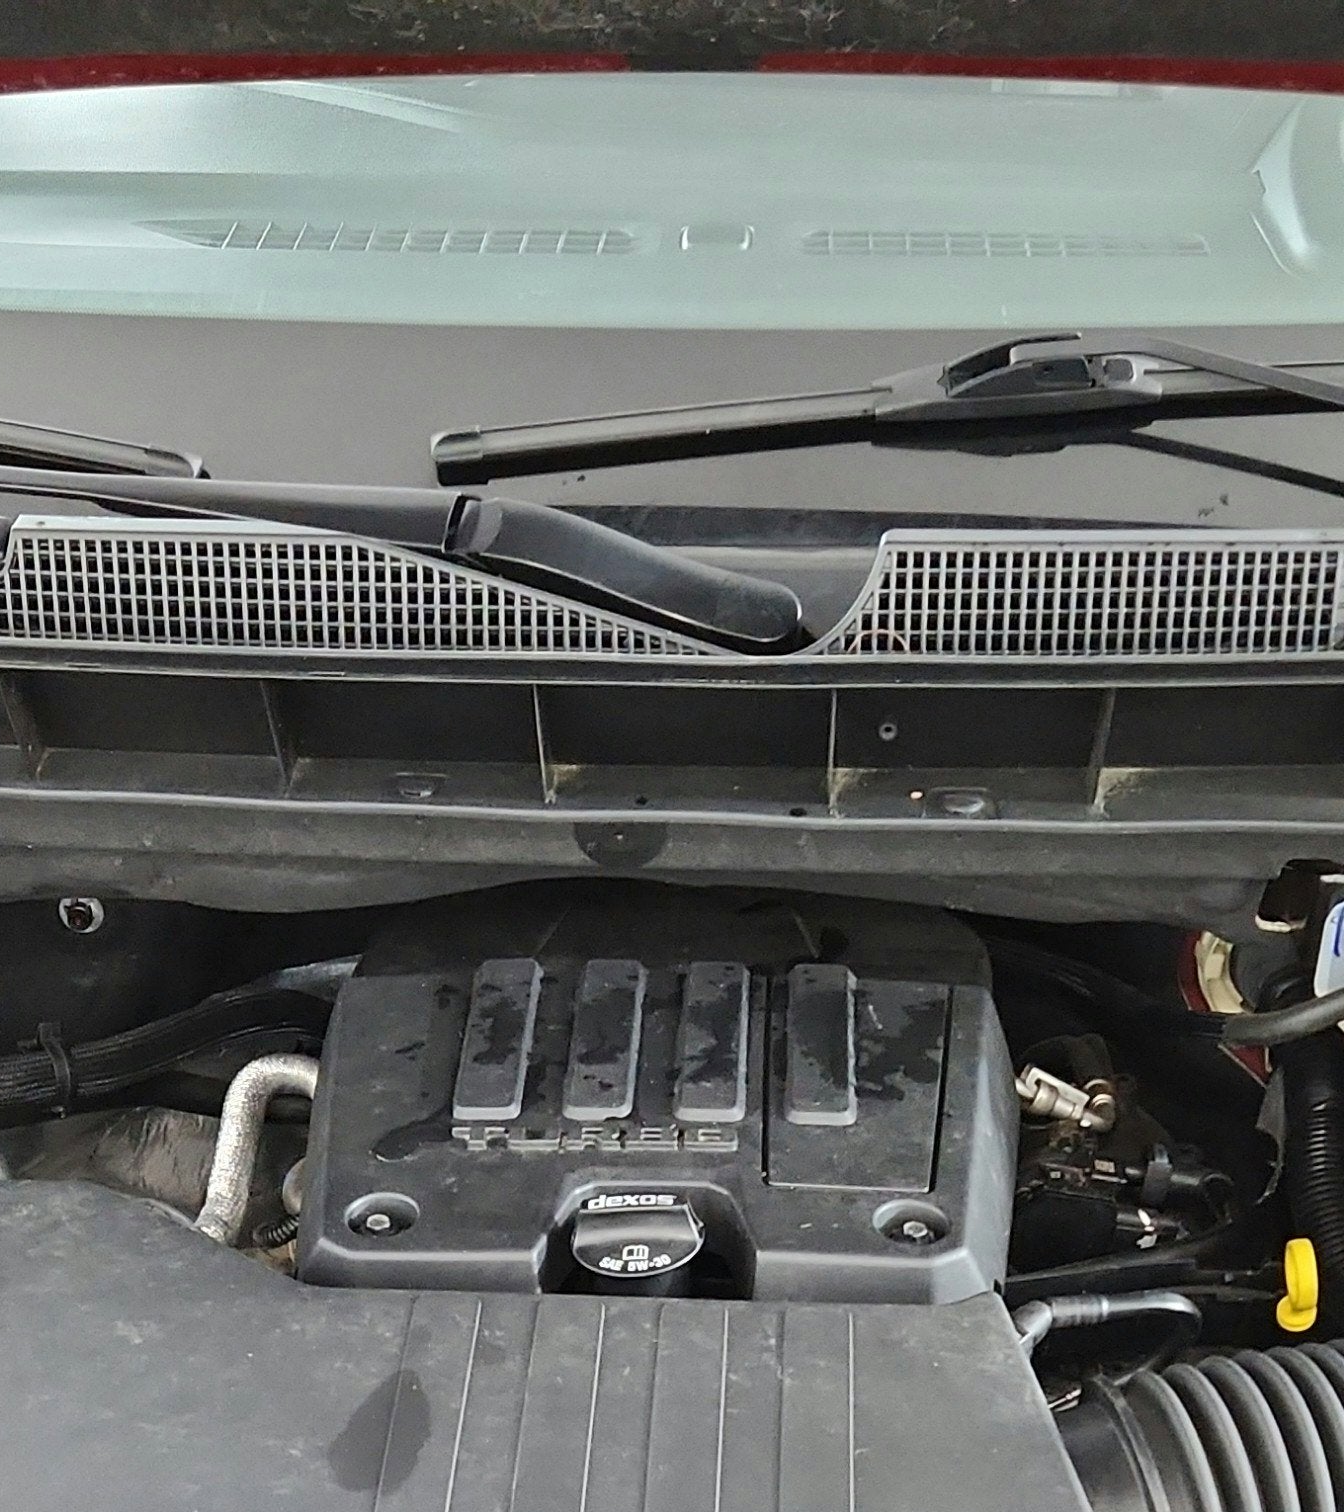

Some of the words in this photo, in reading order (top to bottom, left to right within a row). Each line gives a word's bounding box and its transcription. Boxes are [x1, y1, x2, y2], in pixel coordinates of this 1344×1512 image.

[587, 1194, 678, 1210] dexos
[598, 1256, 624, 1272] SAE
[627, 1253, 672, 1272] 5W-30
